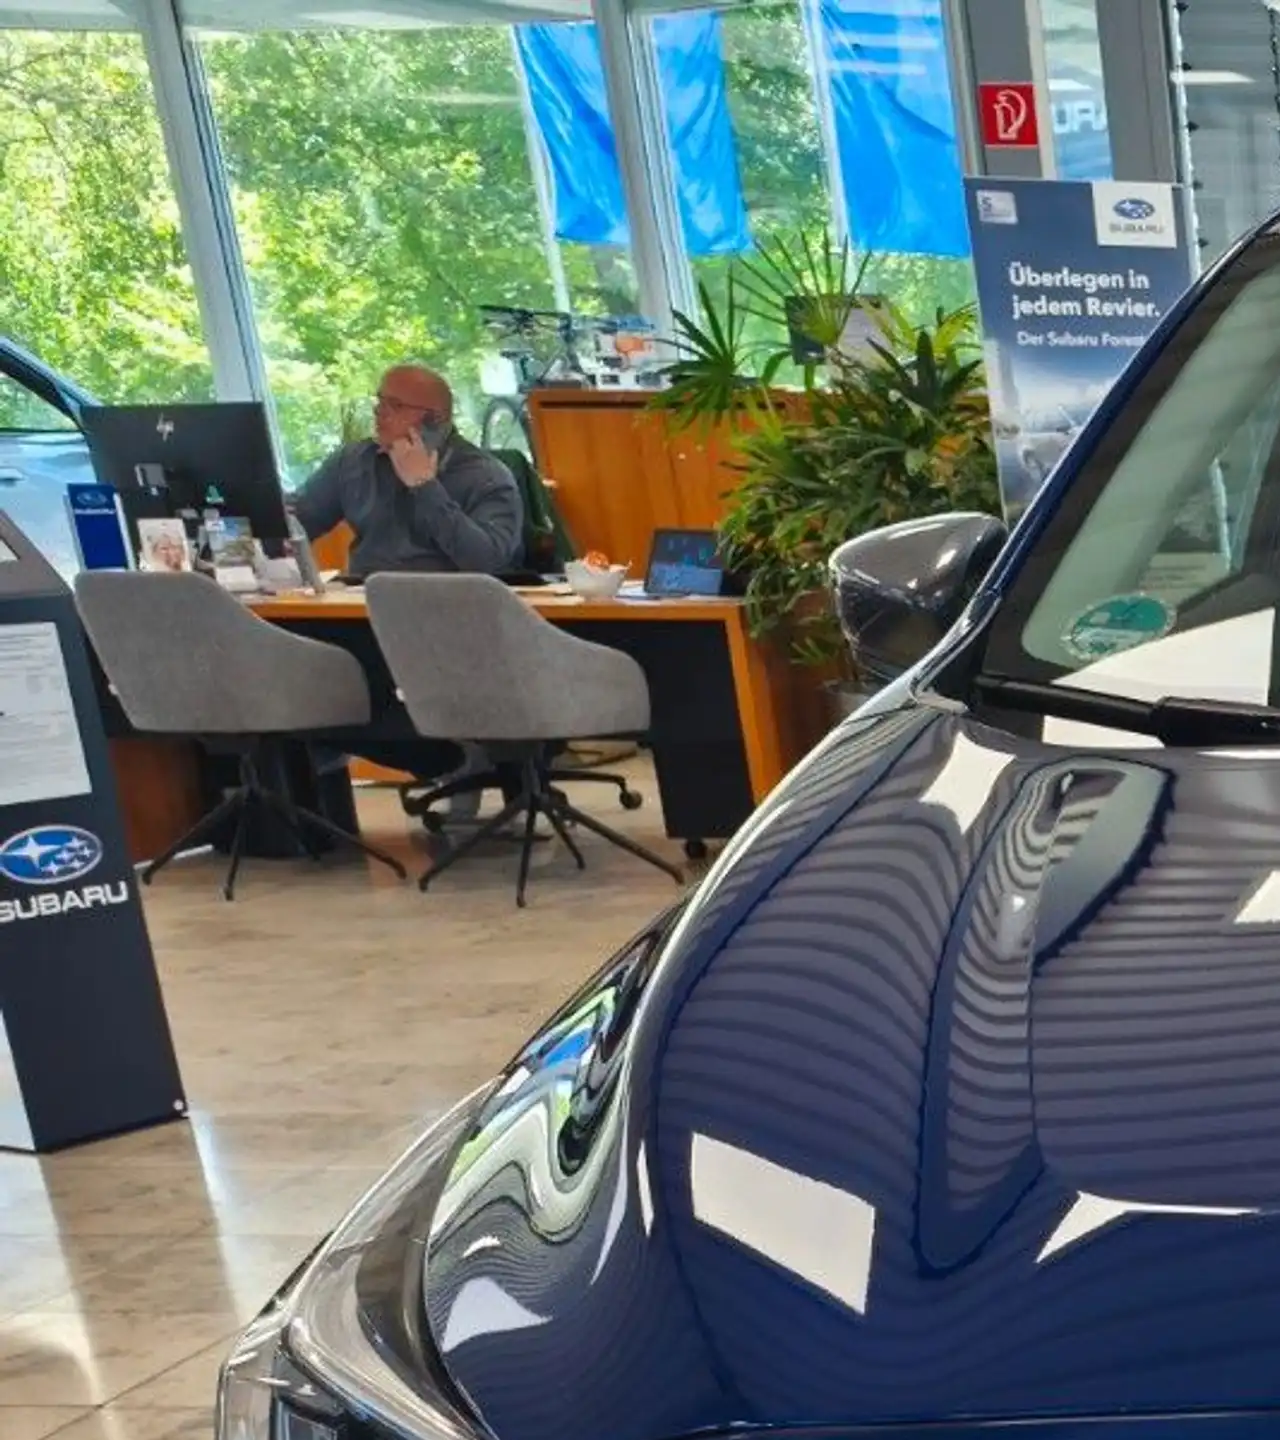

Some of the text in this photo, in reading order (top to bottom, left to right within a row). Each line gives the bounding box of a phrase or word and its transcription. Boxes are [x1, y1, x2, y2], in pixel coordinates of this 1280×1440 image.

[1008, 261, 1150, 293] Überlegen in
[1012, 295, 1161, 320] jedem Revier.
[1016, 330, 1043, 346] Der
[1046, 331, 1099, 347] Subaru
[0, 881, 128, 923] SUBARU
